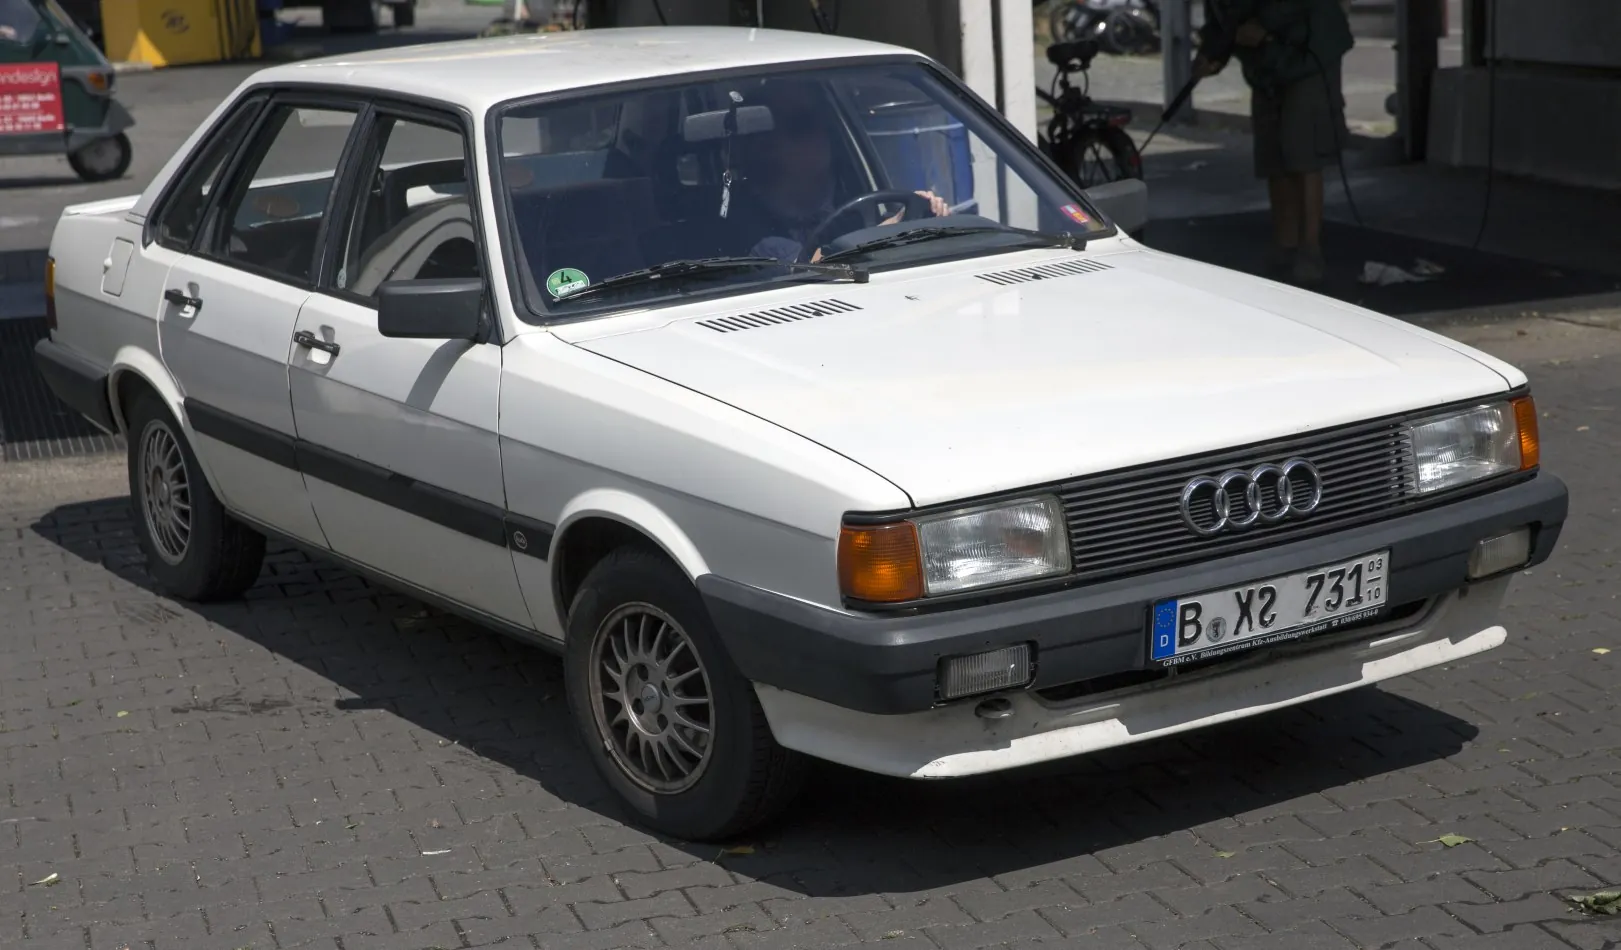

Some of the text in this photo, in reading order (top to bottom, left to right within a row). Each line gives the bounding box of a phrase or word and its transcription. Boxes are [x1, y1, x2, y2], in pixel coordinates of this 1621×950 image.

[560, 271, 573, 283] 4
[1368, 557, 1383, 572] 03
[1367, 586, 1381, 601] 10
[1178, 601, 1203, 648] B
[1304, 562, 1363, 617] 731
[1160, 634, 1169, 648] D
